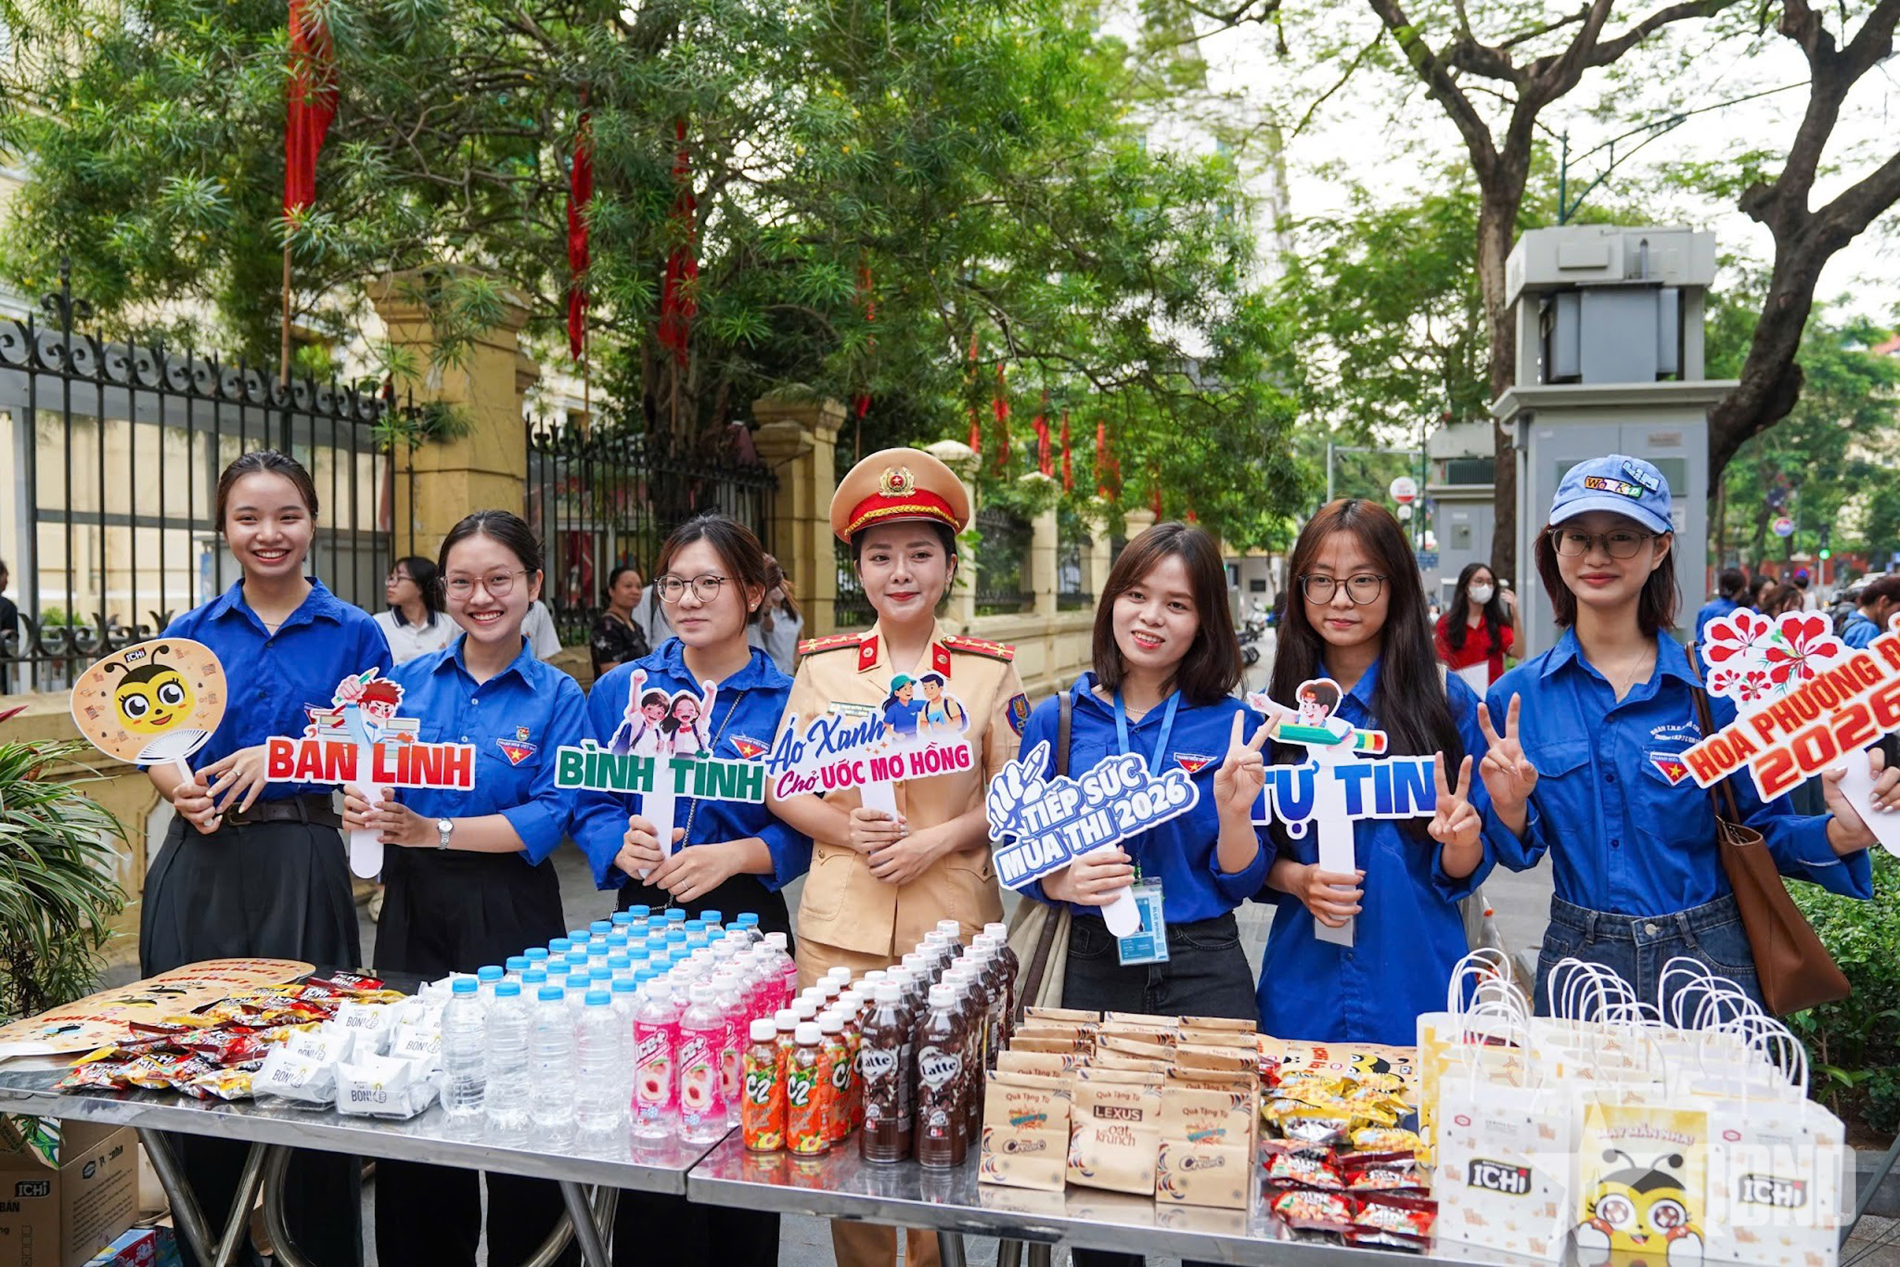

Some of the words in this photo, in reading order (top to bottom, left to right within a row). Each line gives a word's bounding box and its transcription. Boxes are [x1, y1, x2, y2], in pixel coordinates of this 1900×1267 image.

[765, 717, 806, 775] Áo
[807, 713, 886, 758] Xanh
[1686, 727, 1760, 784] HOA
[1748, 653, 1886, 746] PHƯỢNG
[1753, 678, 1900, 797] 2026
[268, 728, 358, 781] BẢN
[558, 744, 655, 793] BÌNH
[669, 750, 764, 801] TĨNH
[777, 771, 820, 799] Chở
[821, 758, 866, 790] ƯỚC
[869, 753, 905, 782] MƠ
[910, 742, 970, 776] HỒNG
[1020, 782, 1080, 834] TIẾP
[1082, 758, 1141, 805] SỨC
[1334, 761, 1436, 816] TIN
[998, 832, 1066, 882] MÙA
[1063, 809, 1115, 851] THI
[1115, 773, 1189, 830] 2026
[746, 1074, 772, 1103] C2
[787, 1075, 811, 1105] C2
[921, 1061, 956, 1076] Latte
[1095, 1106, 1141, 1121] LEXUS
[1095, 1129, 1136, 1147] krunch
[1108, 1125, 1129, 1138] oat
